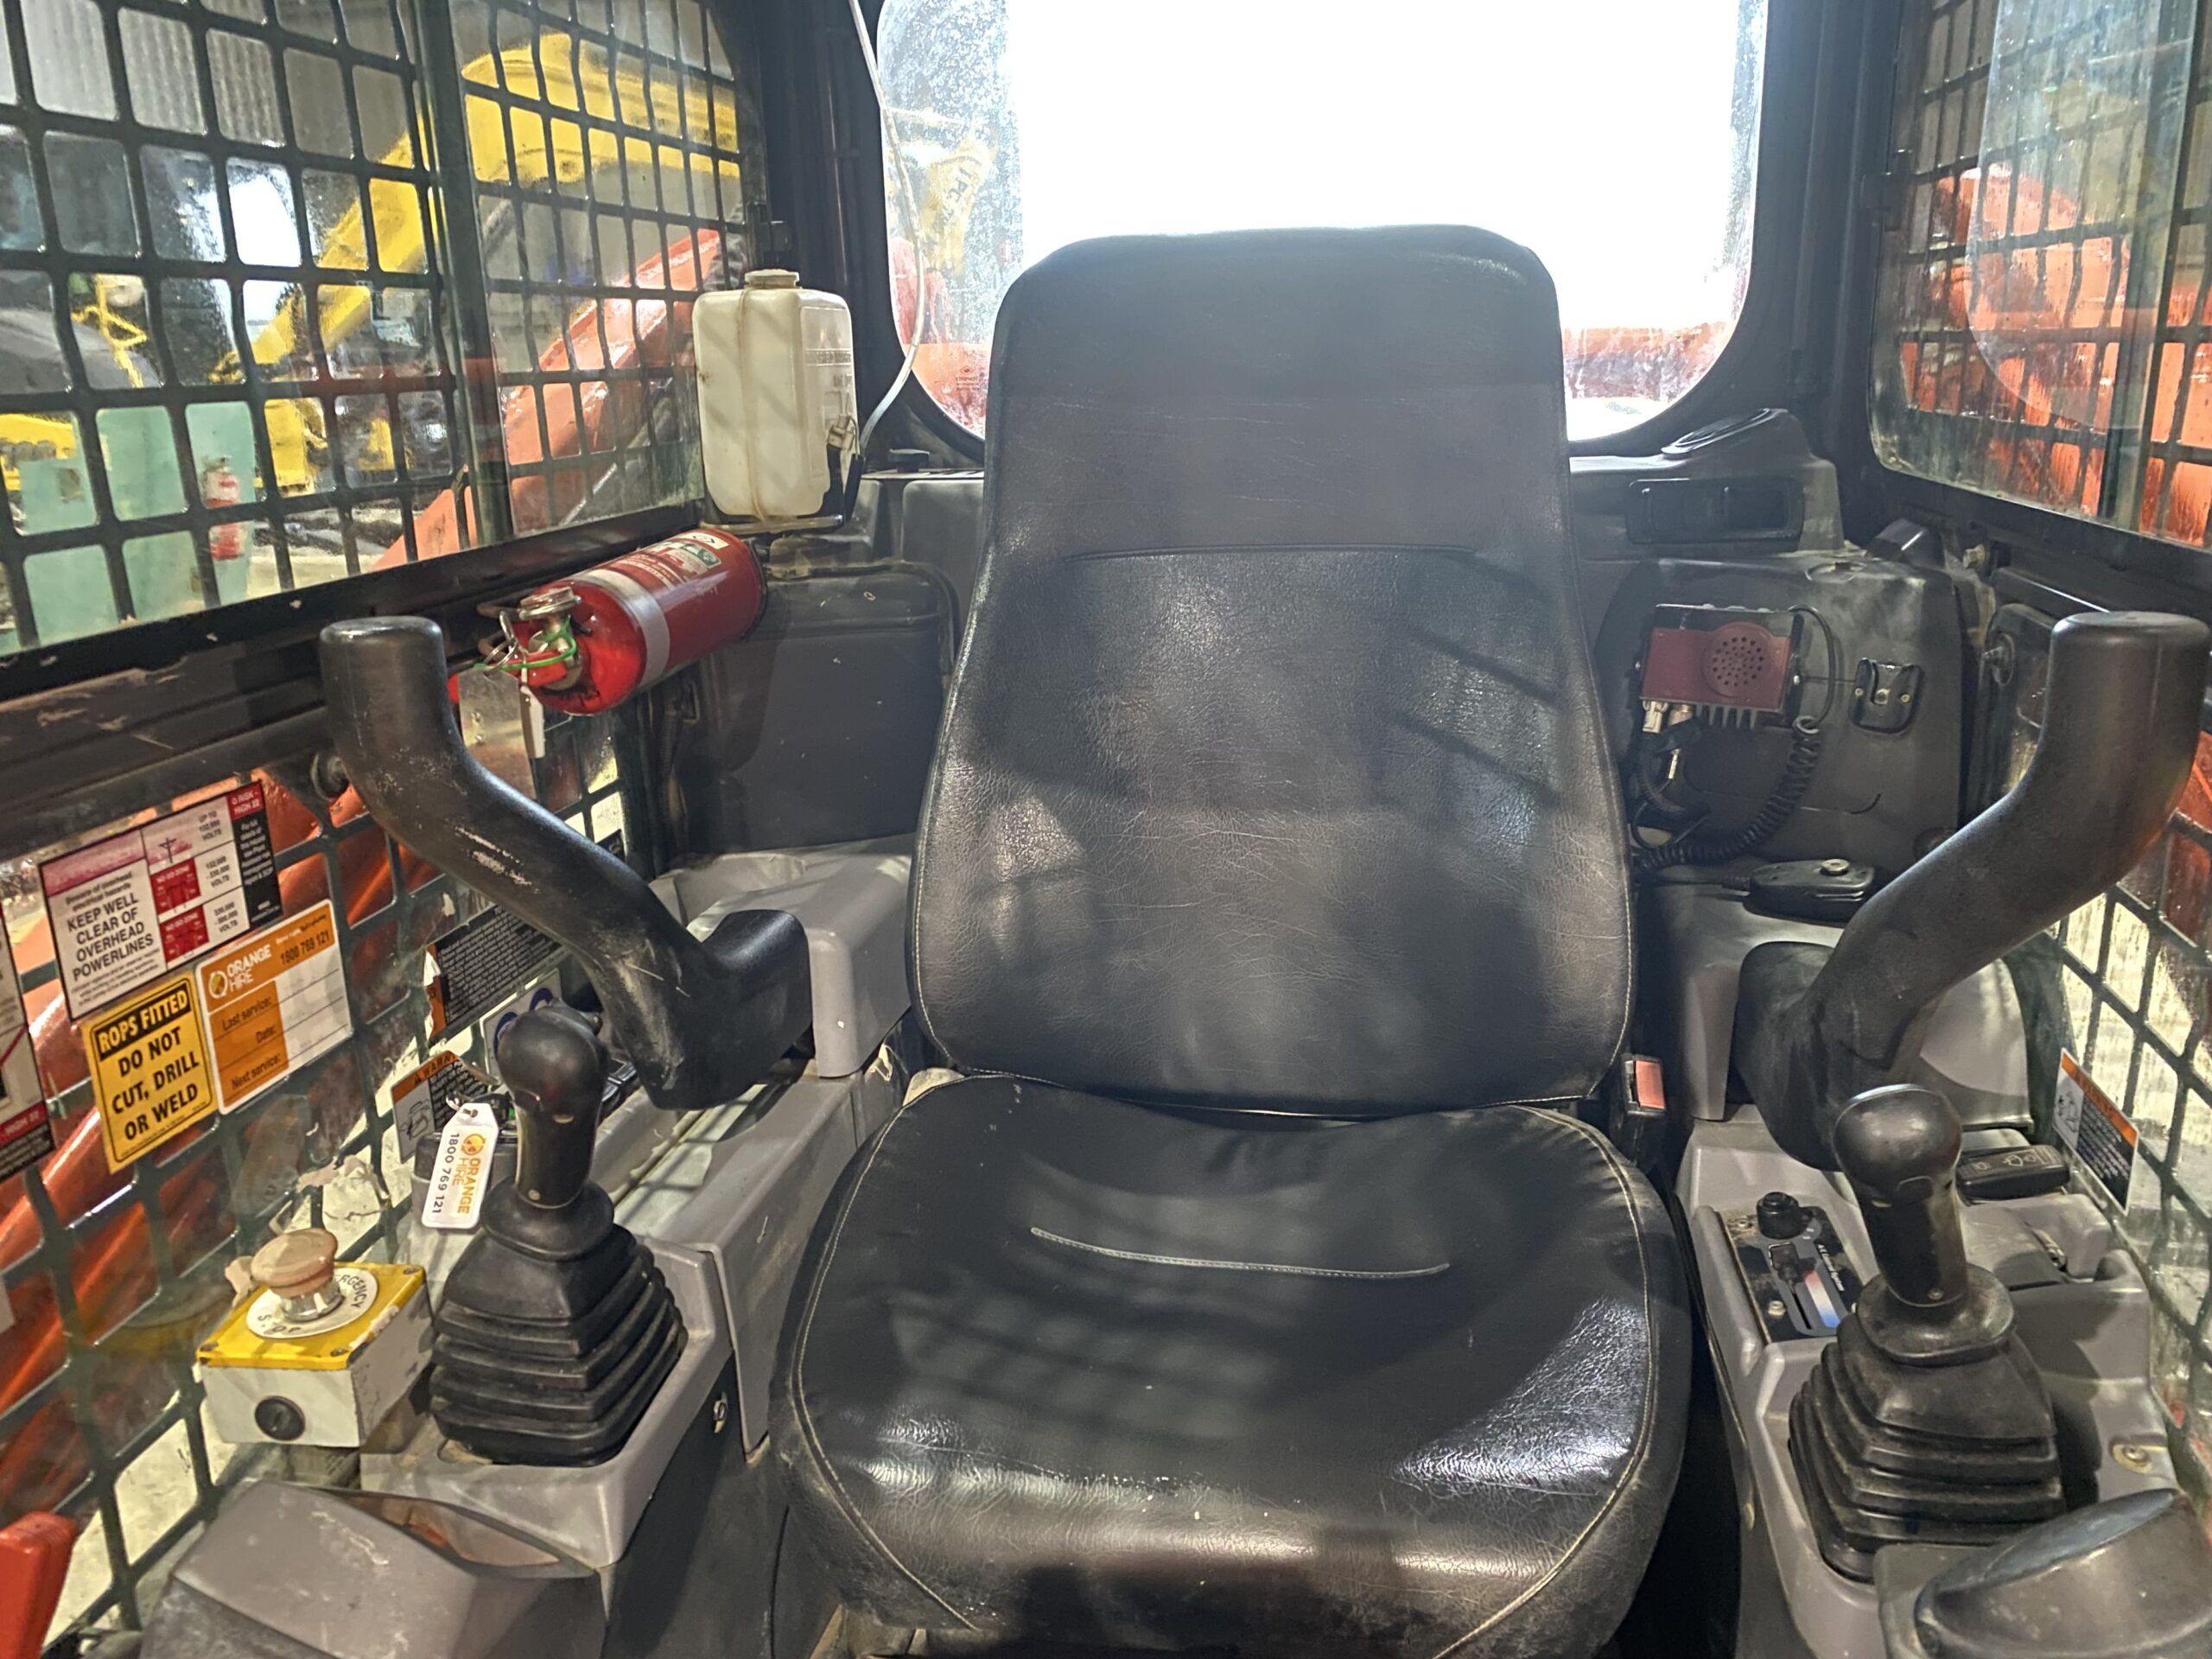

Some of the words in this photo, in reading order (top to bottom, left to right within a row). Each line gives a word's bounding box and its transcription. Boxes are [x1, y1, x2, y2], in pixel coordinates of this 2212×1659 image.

[201, 829, 222, 841] VOLTS
[211, 874, 230, 887] VOLTS
[67, 907, 101, 932] KEEP
[103, 893, 139, 916] WELL
[76, 917, 119, 944] CLEAR
[122, 907, 138, 924] OF
[219, 919, 238, 932] VOLTS
[76, 921, 144, 962] OVERHEAD
[316, 930, 329, 947] 121
[73, 933, 154, 982] POWERLINES
[227, 944, 272, 977] ORANGE
[229, 968, 254, 992] HIRE
[97, 1015, 139, 1053] ROPS
[139, 989, 188, 1030] FITTED
[222, 1013, 240, 1031] Last
[118, 1050, 143, 1077] DO
[148, 1027, 181, 1060] NOT
[112, 1082, 149, 1114] CUT,
[153, 1051, 200, 1090] DRILL
[231, 1071, 250, 1090] Next
[124, 1114, 149, 1141] OR
[151, 1084, 199, 1123] WELD
[445, 1133, 460, 1163] 1800
[438, 1167, 452, 1191] 769
[452, 1157, 469, 1186] HIRE
[457, 1158, 481, 1214] ORANGE
[431, 1195, 445, 1213] 121
